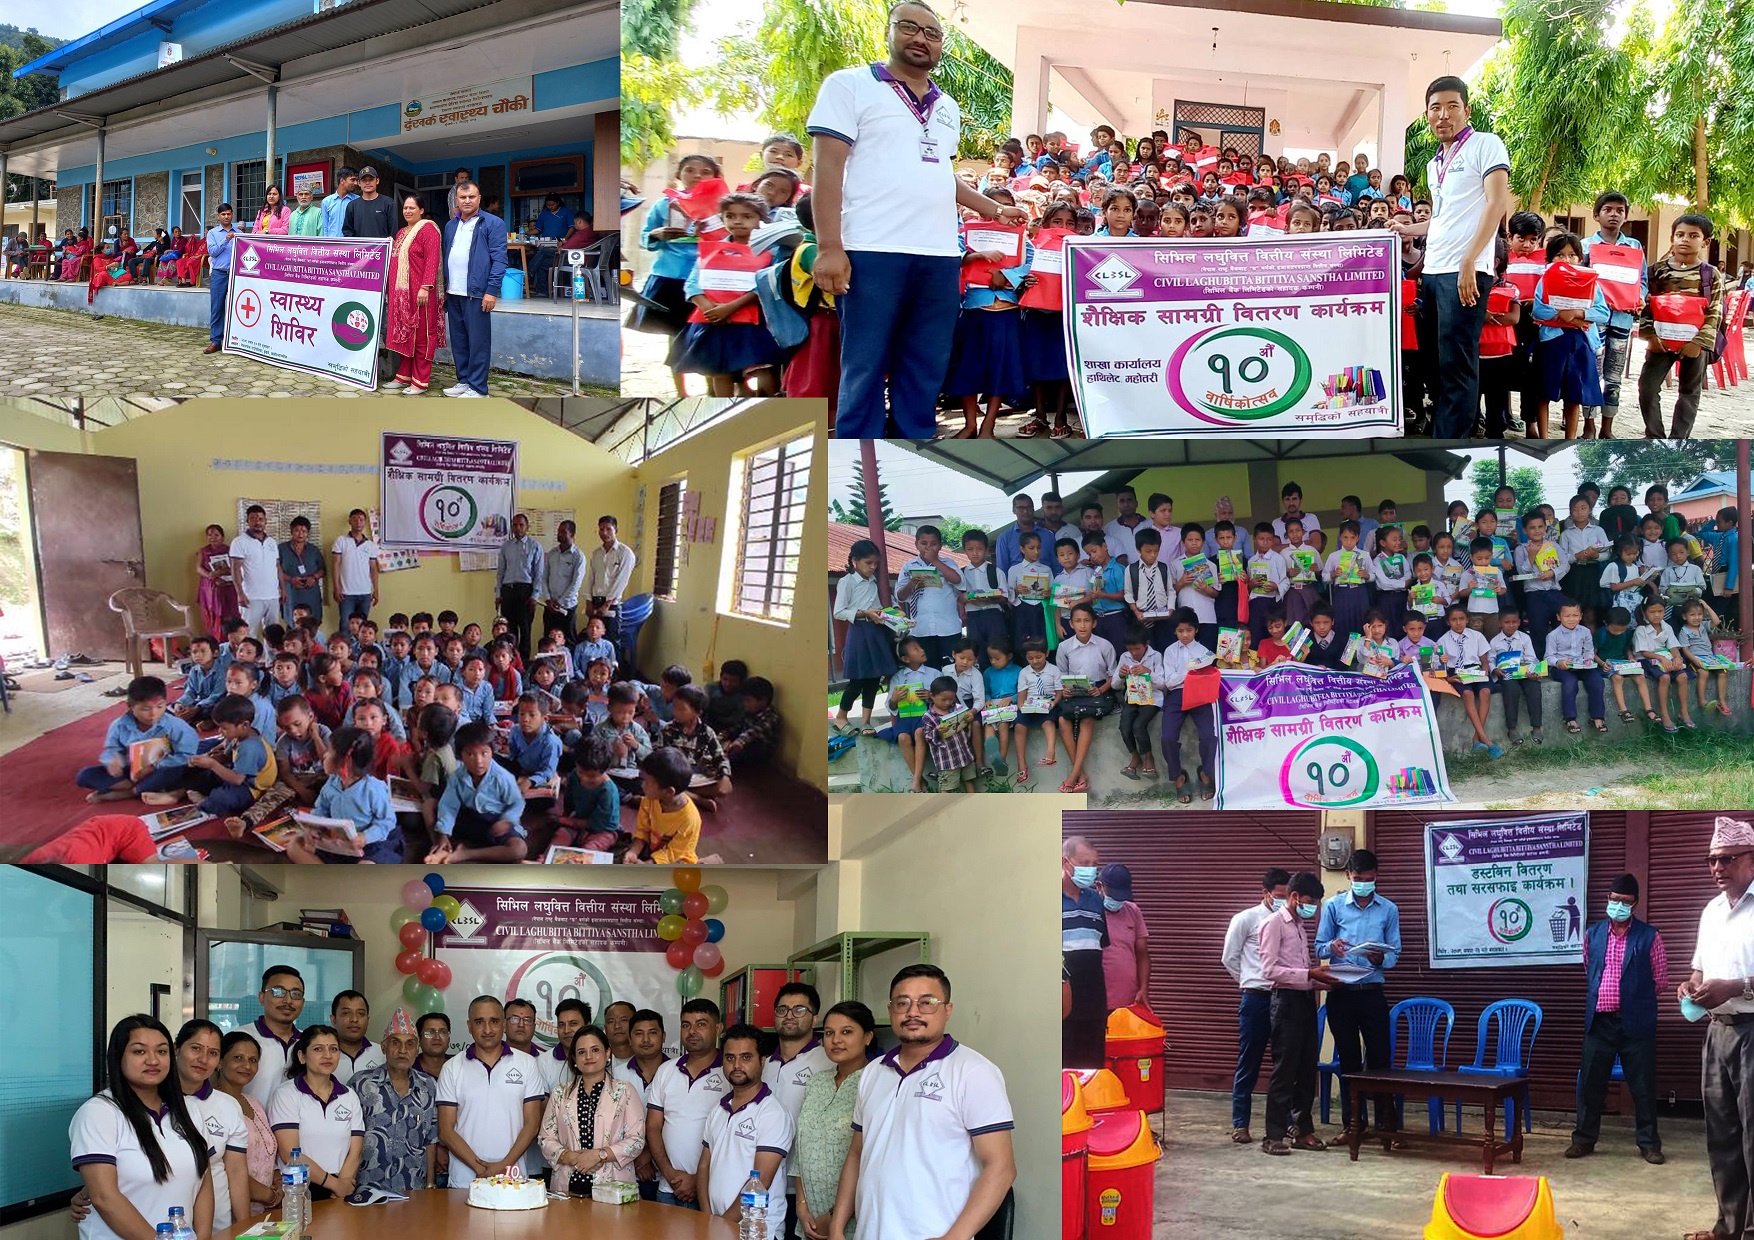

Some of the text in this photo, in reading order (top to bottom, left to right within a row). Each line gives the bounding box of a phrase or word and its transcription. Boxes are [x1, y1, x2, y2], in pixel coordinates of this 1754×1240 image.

[492, 94, 530, 114] चौकी
[353, 246, 382, 260] लिमिटेड
[1154, 244, 1385, 266] सिभिल लघुवित्त वित्तीय संस्था लिमिटेड
[1154, 270, 1385, 288] CIVIL LAGHUBITTA BITTIYA SANSTHA LIMITED
[270, 291, 325, 316] स्वास्थ्य
[1081, 296, 1386, 327] शैक्षिक सामग्री वितरण कार्यक्रम
[270, 313, 318, 347] शिविर
[1084, 357, 1162, 370] शाखा कार्यालय
[1207, 353, 1269, 394] १०
[1205, 388, 1279, 410] वार्षिकोत्सव
[436, 499, 460, 522] १०
[1265, 674, 1292, 686] सिभिल
[1328, 674, 1353, 685] वित्तीय
[1267, 696, 1286, 706] CIVIL
[1226, 725, 1266, 745] शैक्षिक
[1270, 717, 1313, 737] सामग्री
[1319, 713, 1363, 732] वितरण
[1368, 702, 1423, 724] कार्यक्रम
[1306, 762, 1350, 796] १०
[1516, 862, 1553, 876] वितरण
[1447, 883, 1467, 896] तथा
[1522, 875, 1565, 892] कार्यक्रम
[496, 896, 530, 911] सिभिल
[534, 898, 571, 916] लघुवित्त
[575, 899, 606, 913] वित्तीय
[611, 900, 637, 914] संस्था
[495, 925, 519, 936] CIVIL
[520, 926, 572, 937] LAGHUBITTA
[573, 927, 605, 937] BITTIYA
[606, 928, 643, 938] SANSTHA
[504, 1165, 520, 1179] 10
